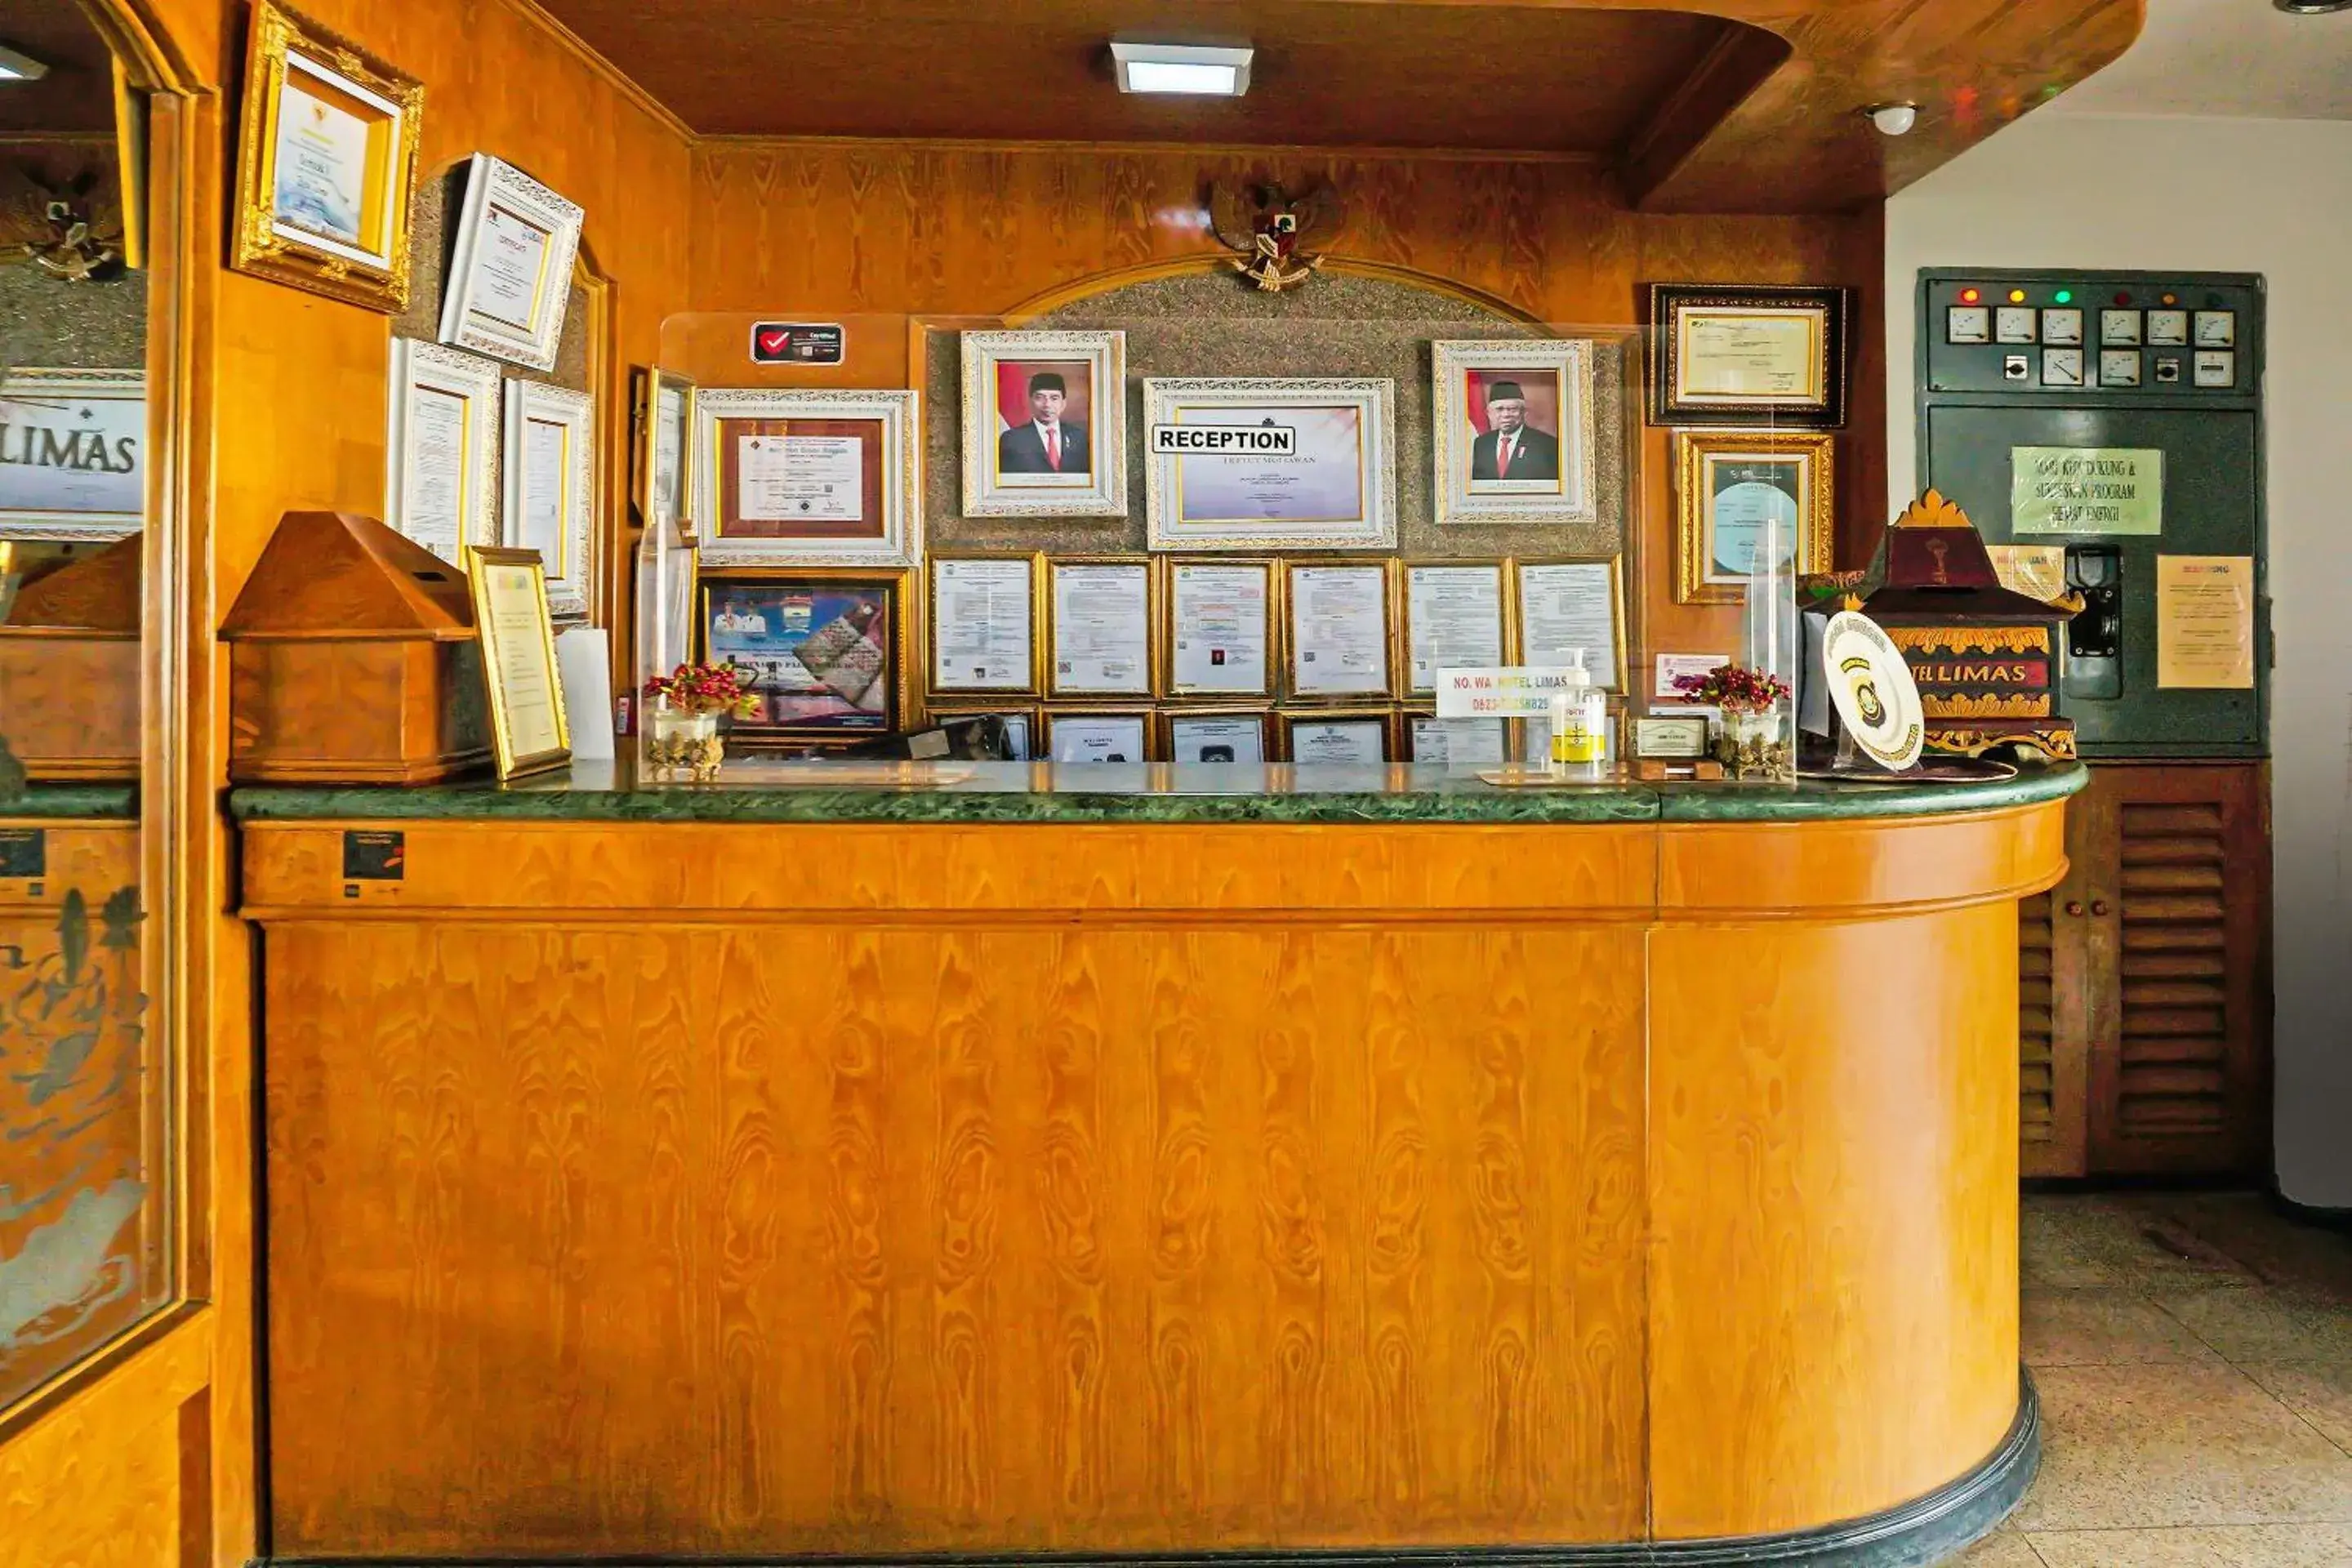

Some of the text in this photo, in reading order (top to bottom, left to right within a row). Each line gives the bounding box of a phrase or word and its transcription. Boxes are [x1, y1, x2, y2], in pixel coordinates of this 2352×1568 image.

[0, 422, 136, 474] LIMAS
[1160, 430, 1289, 449] RECEPTION
[1454, 675, 1568, 689] NO. WA HTEL LIMAS
[1911, 664, 2026, 682] TEL LIMAS
